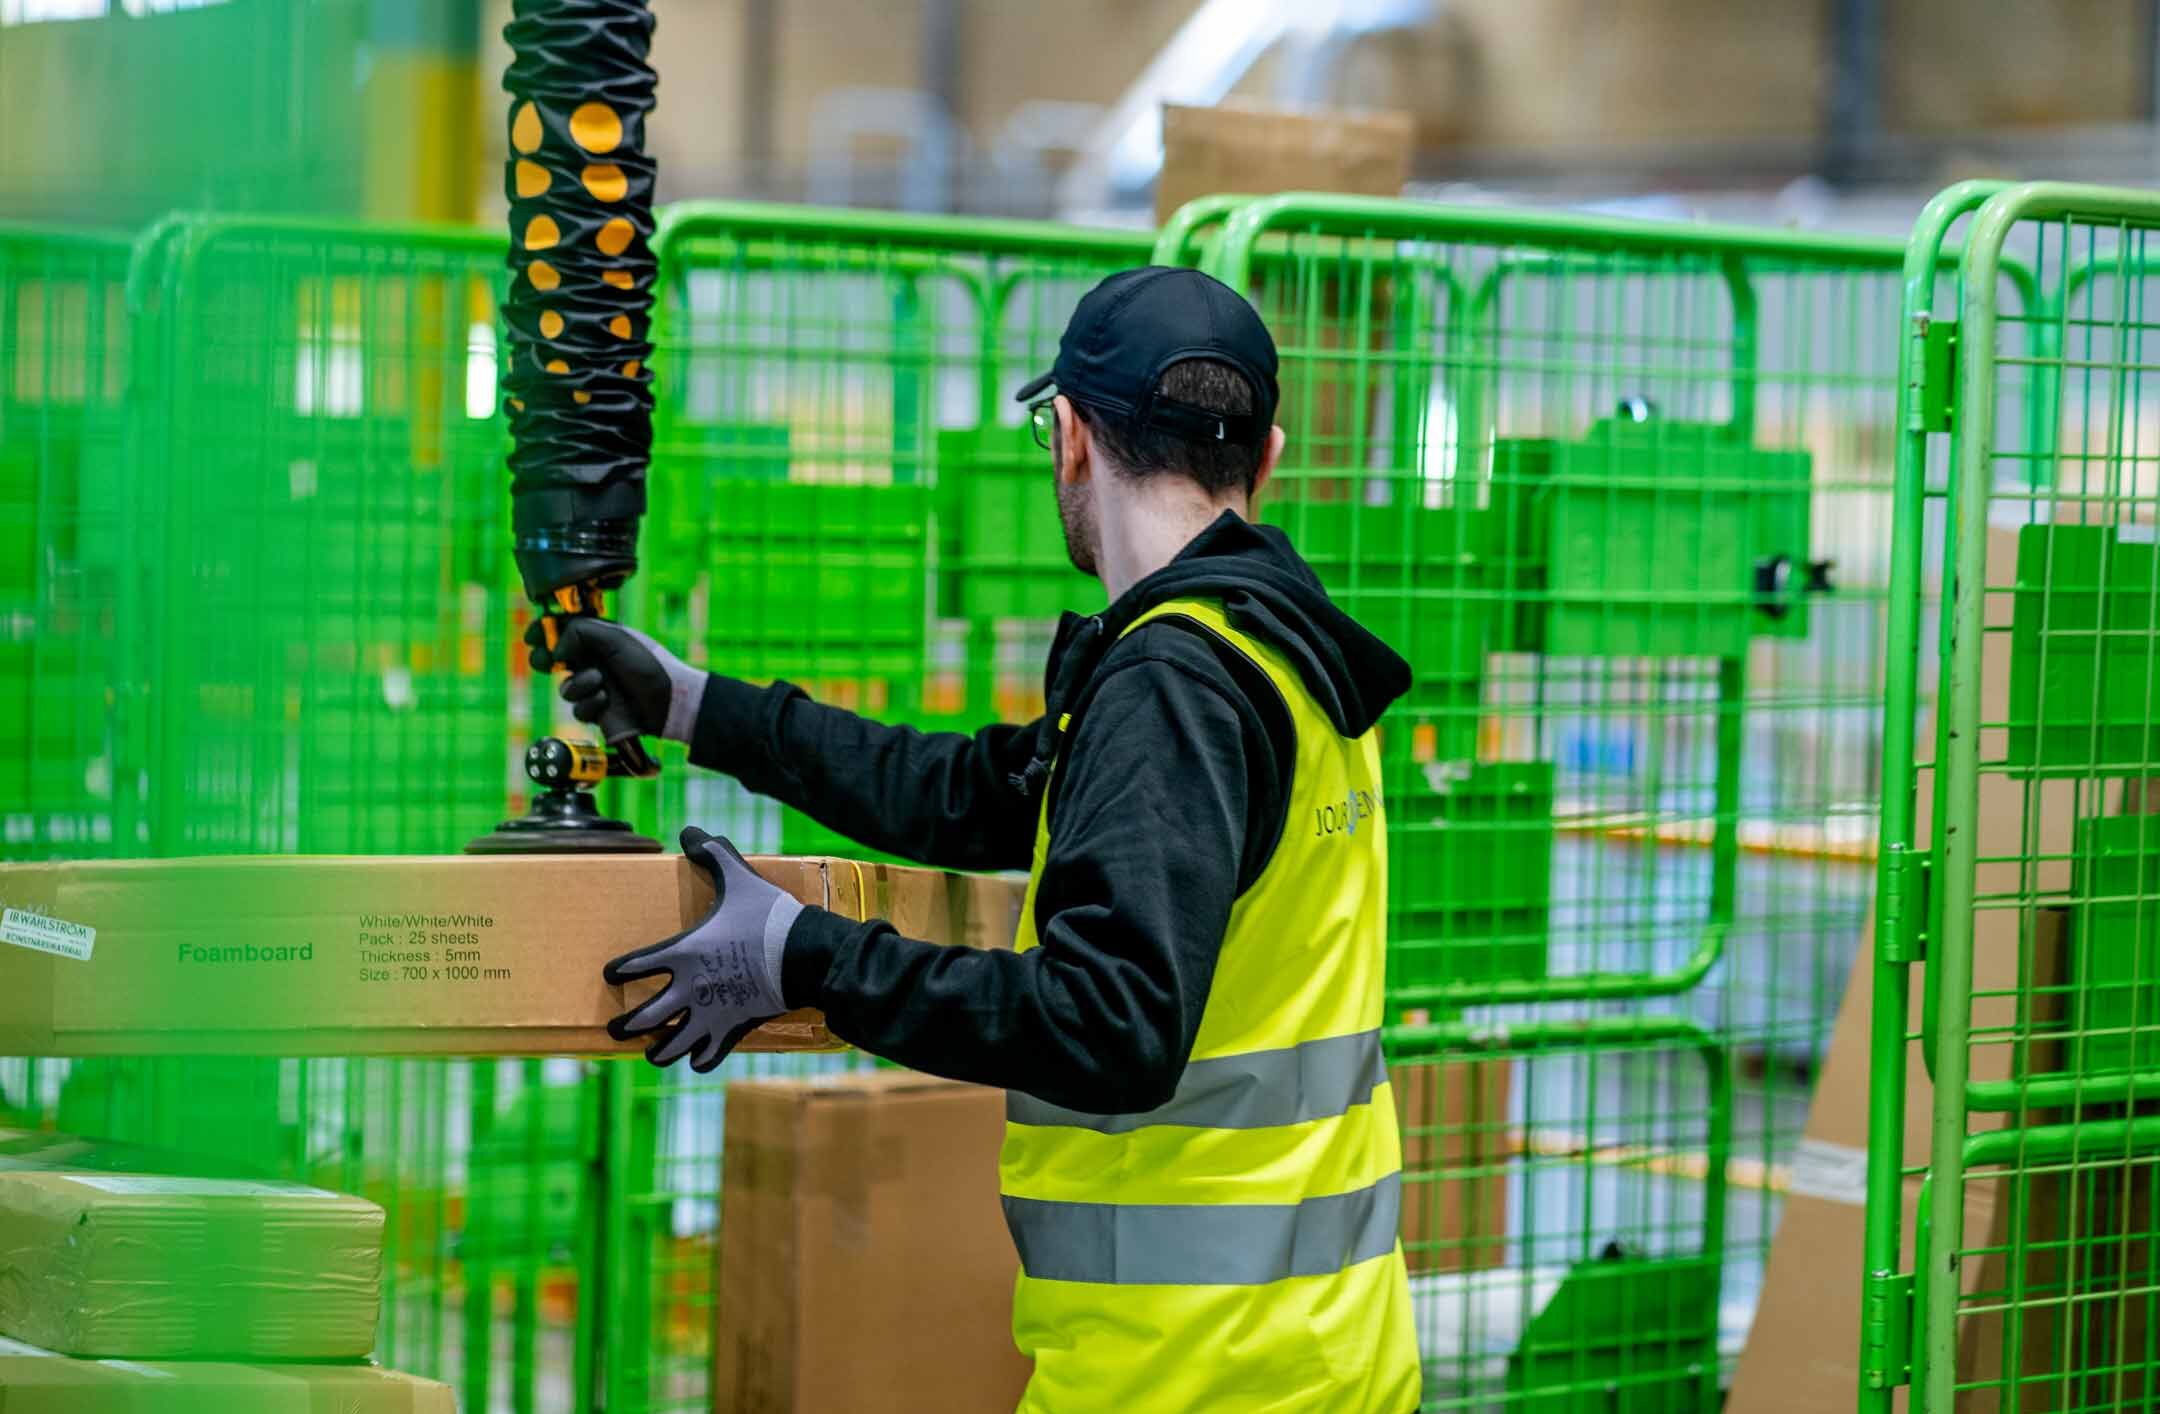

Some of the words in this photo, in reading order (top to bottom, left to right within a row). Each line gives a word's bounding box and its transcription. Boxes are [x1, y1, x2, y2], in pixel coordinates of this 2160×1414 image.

[359, 914, 493, 928] White/White/White
[359, 932, 394, 945] Pack
[408, 931, 426, 945] 25
[431, 932, 479, 945] sheets
[178, 942, 313, 962] Foamboard
[359, 950, 431, 963] Thickness
[445, 949, 481, 962] 5mm
[359, 968, 390, 982] Size
[402, 966, 428, 980] 700
[432, 970, 440, 980] x
[445, 966, 479, 980] 1000
[483, 968, 512, 980] mm
